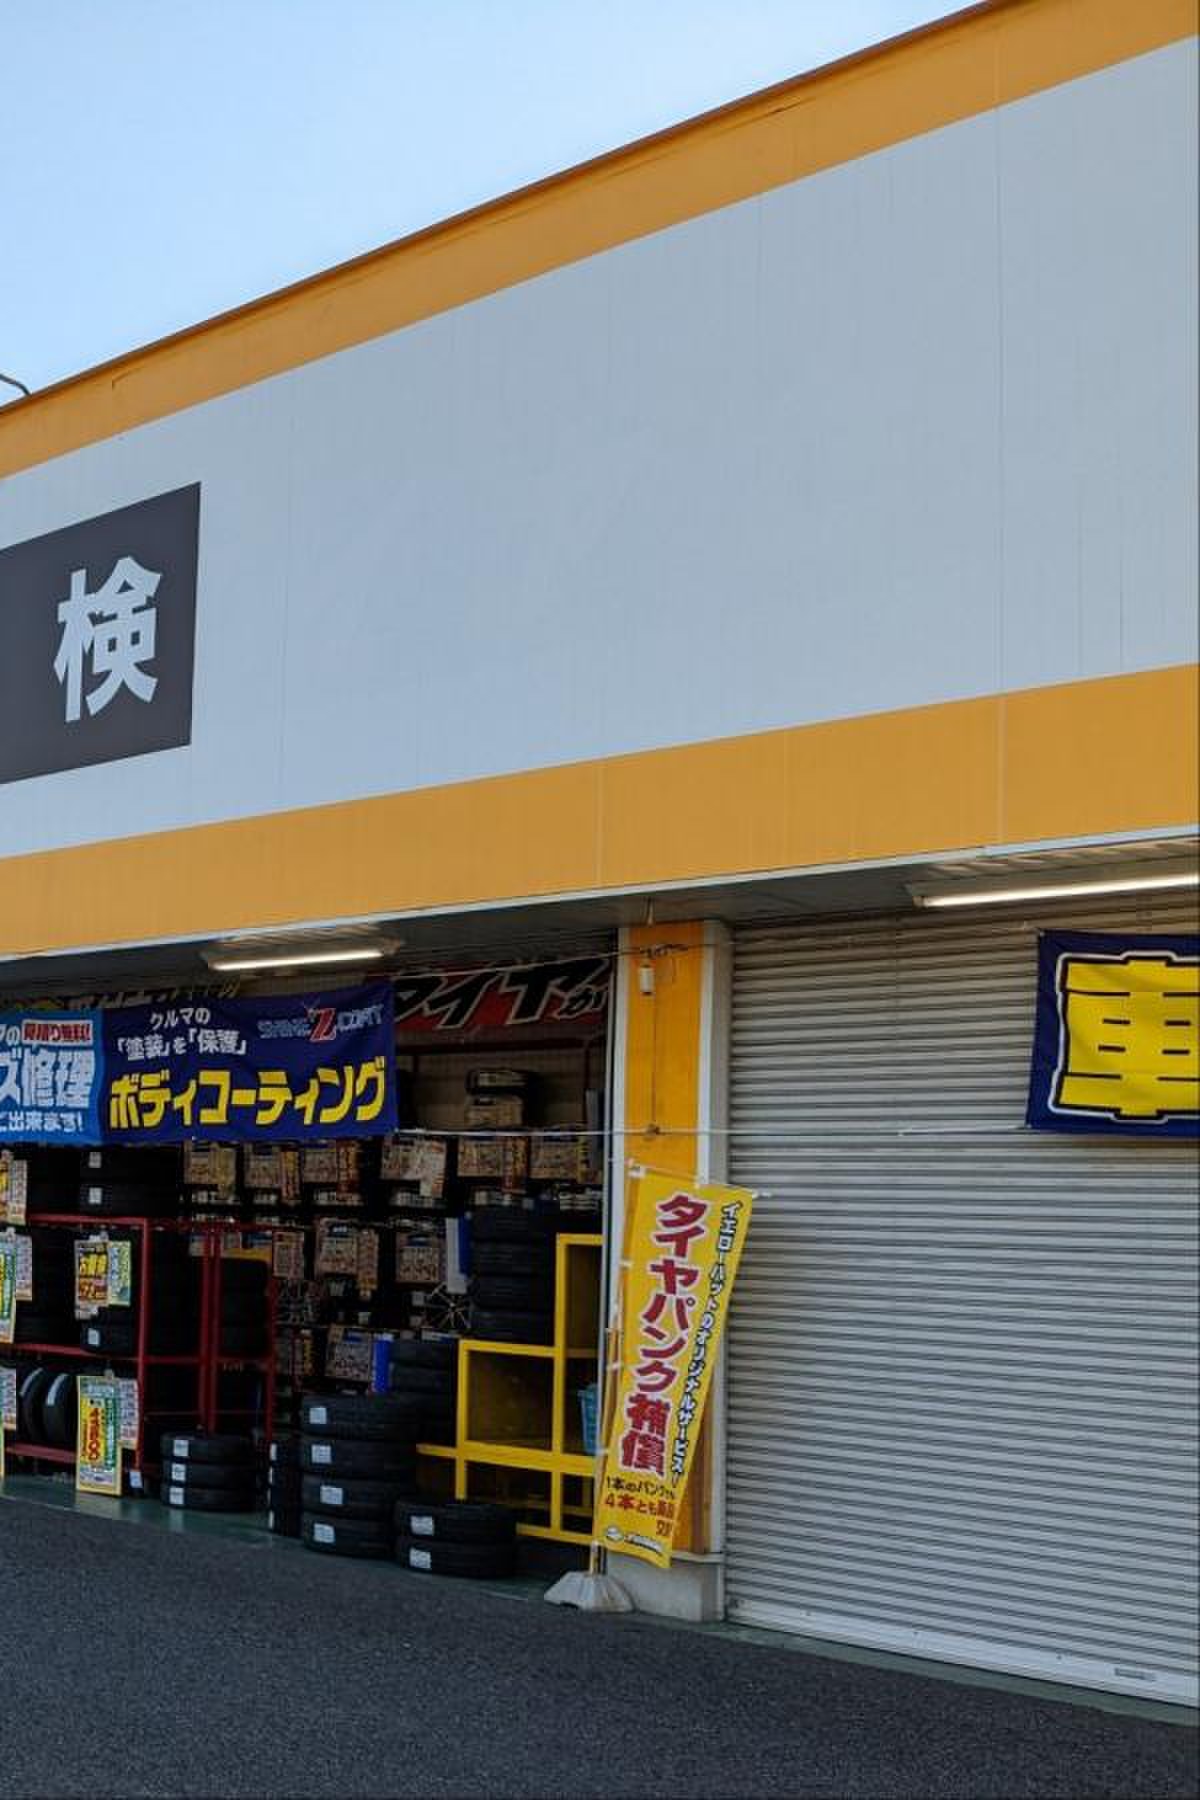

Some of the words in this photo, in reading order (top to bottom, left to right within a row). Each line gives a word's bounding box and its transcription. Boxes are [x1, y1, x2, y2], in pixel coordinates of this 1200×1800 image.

[150, 1007, 211, 1031] クルマの
[110, 1056, 386, 1129] ボディコーティング
[621, 1193, 707, 1477] タイヤパンク補償
